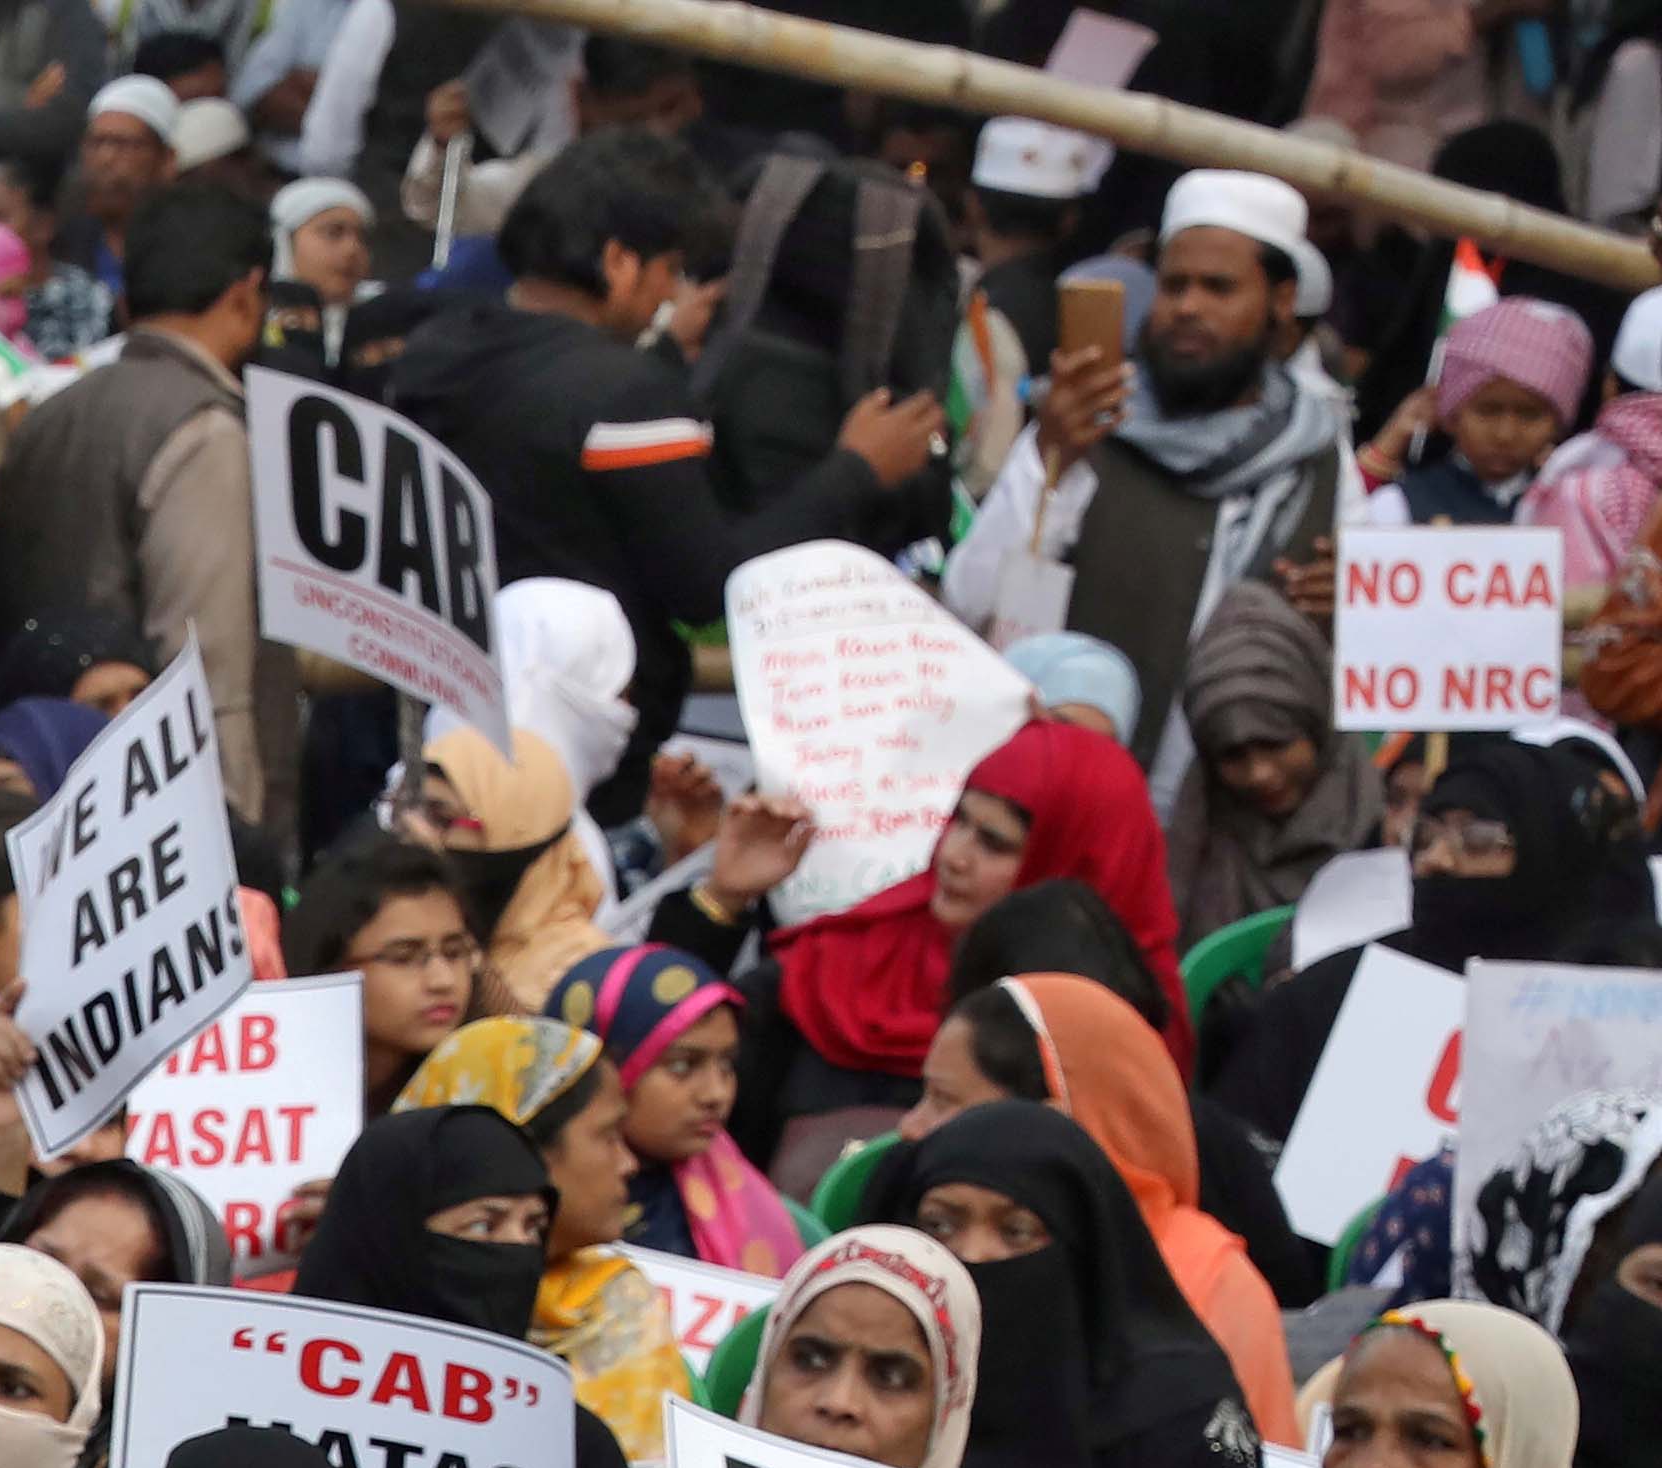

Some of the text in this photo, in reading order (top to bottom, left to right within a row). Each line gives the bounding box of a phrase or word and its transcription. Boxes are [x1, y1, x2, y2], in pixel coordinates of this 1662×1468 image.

[288, 393, 491, 654] CAB
[1346, 560, 1556, 610] NO CAA
[120, 686, 211, 816] ALL
[1345, 664, 1559, 713] NO NRC
[69, 821, 188, 971] ARE
[29, 880, 248, 1114] INDIANS
[230, 1325, 543, 1426] “CAB”
